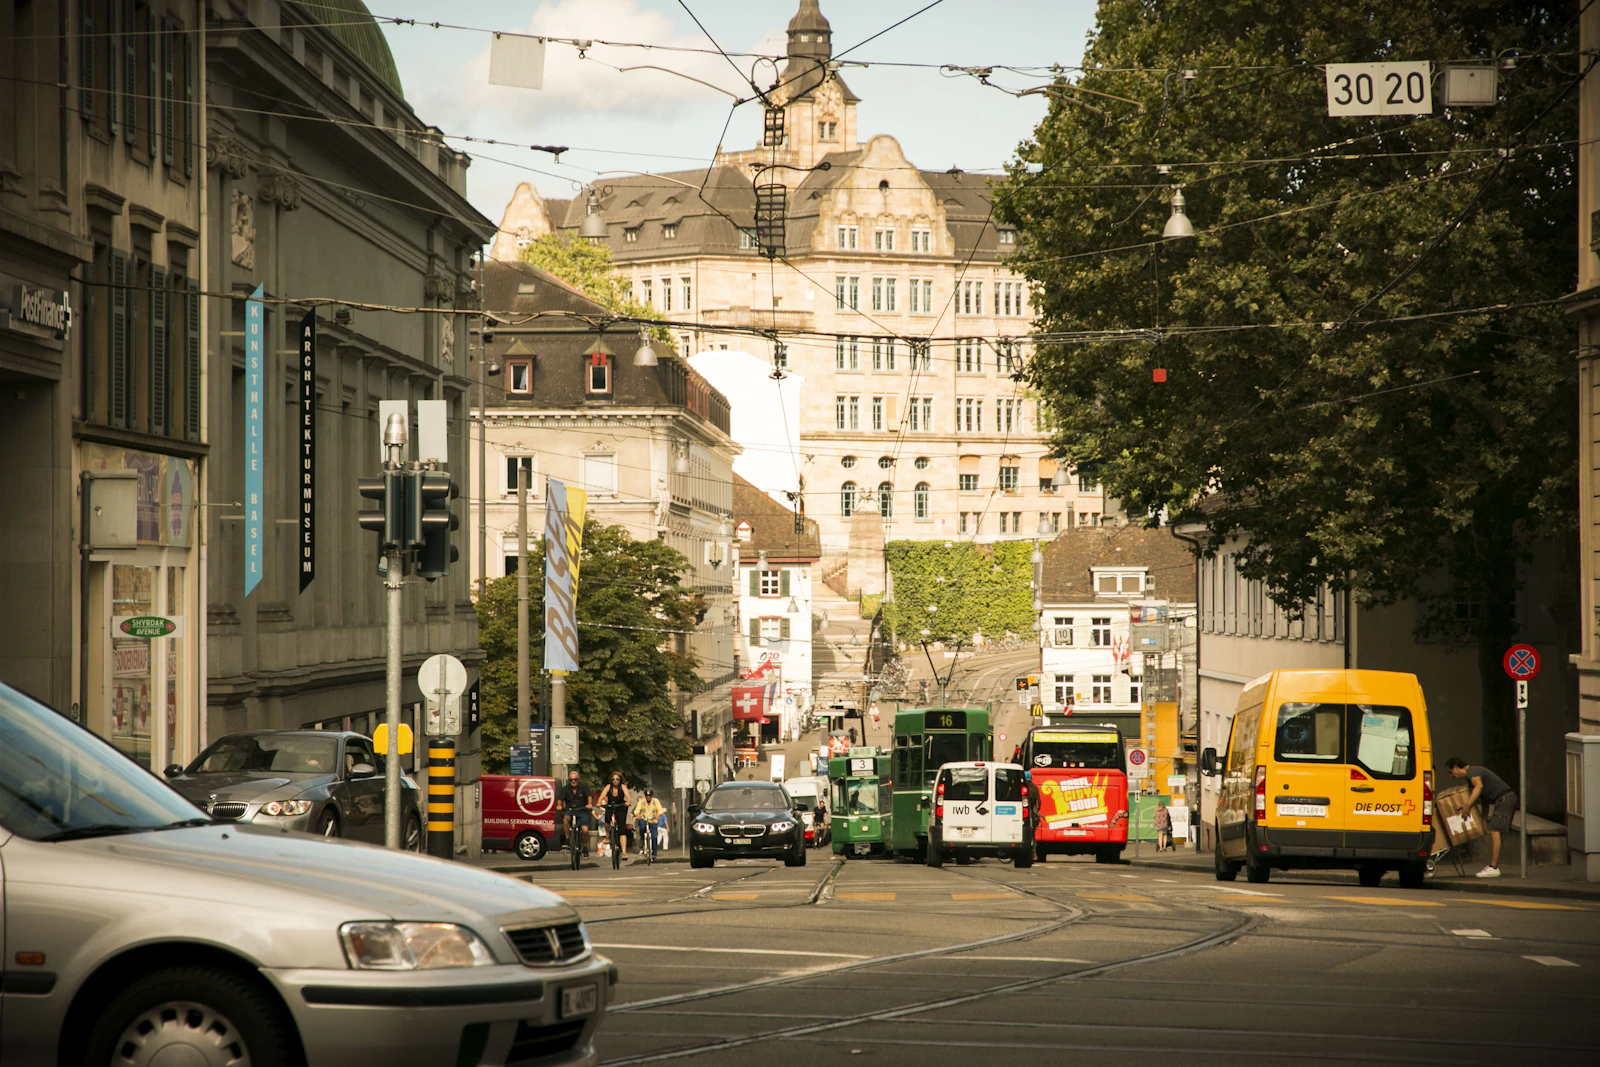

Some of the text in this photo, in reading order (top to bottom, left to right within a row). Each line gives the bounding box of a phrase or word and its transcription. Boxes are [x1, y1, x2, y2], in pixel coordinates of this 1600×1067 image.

[1334, 71, 1424, 106] 30 20
[21, 284, 65, 331] PostFinance
[250, 305, 259, 573] KUNSTHALLE BASEL
[303, 326, 312, 573] ARCHITEKTURMUSEUM
[132, 619, 165, 627] SHYRDAK
[1058, 629, 1068, 639] 10
[940, 715, 953, 727] 16
[859, 759, 866, 769] 3
[1355, 802, 1402, 812] DIE POST
